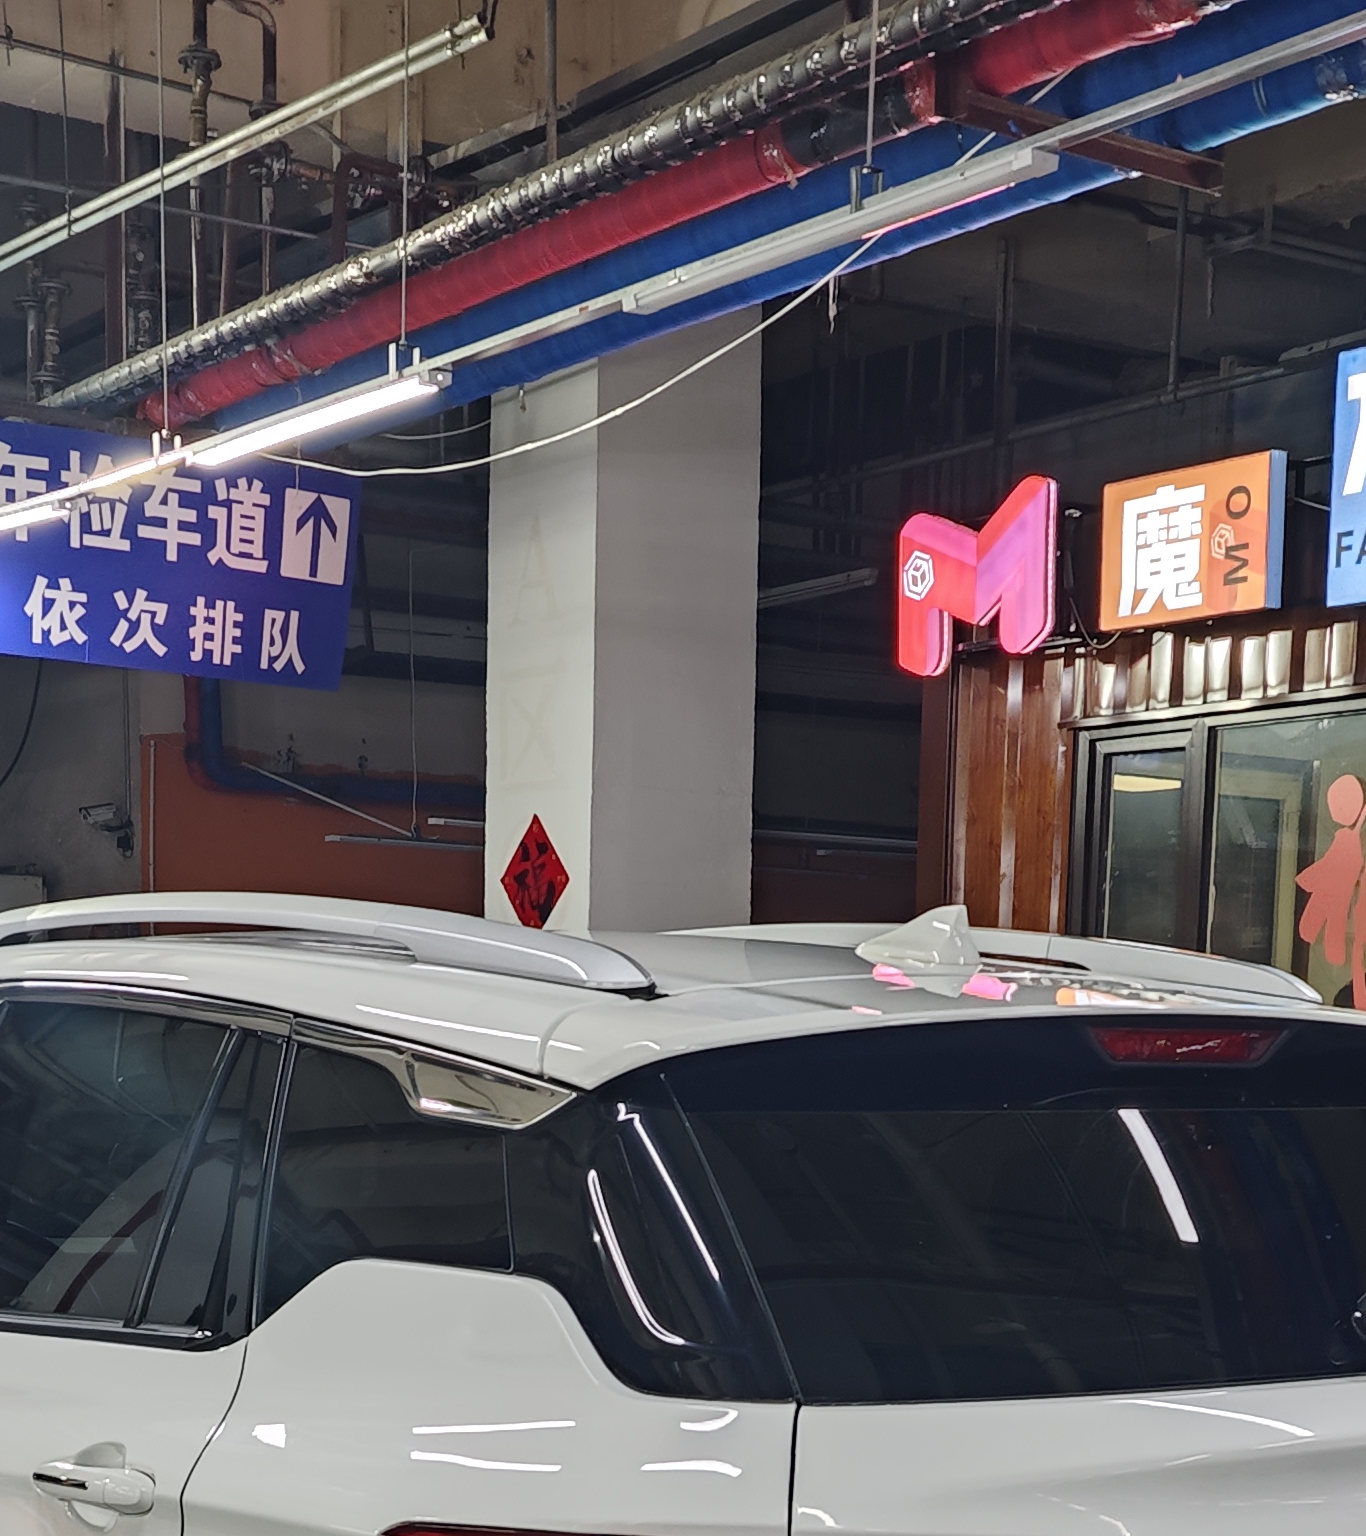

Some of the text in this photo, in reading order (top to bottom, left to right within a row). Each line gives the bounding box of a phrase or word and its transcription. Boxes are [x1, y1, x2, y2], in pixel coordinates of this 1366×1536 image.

[1118, 484, 1206, 617] 魔
[24, 574, 306, 676] 依次排队
